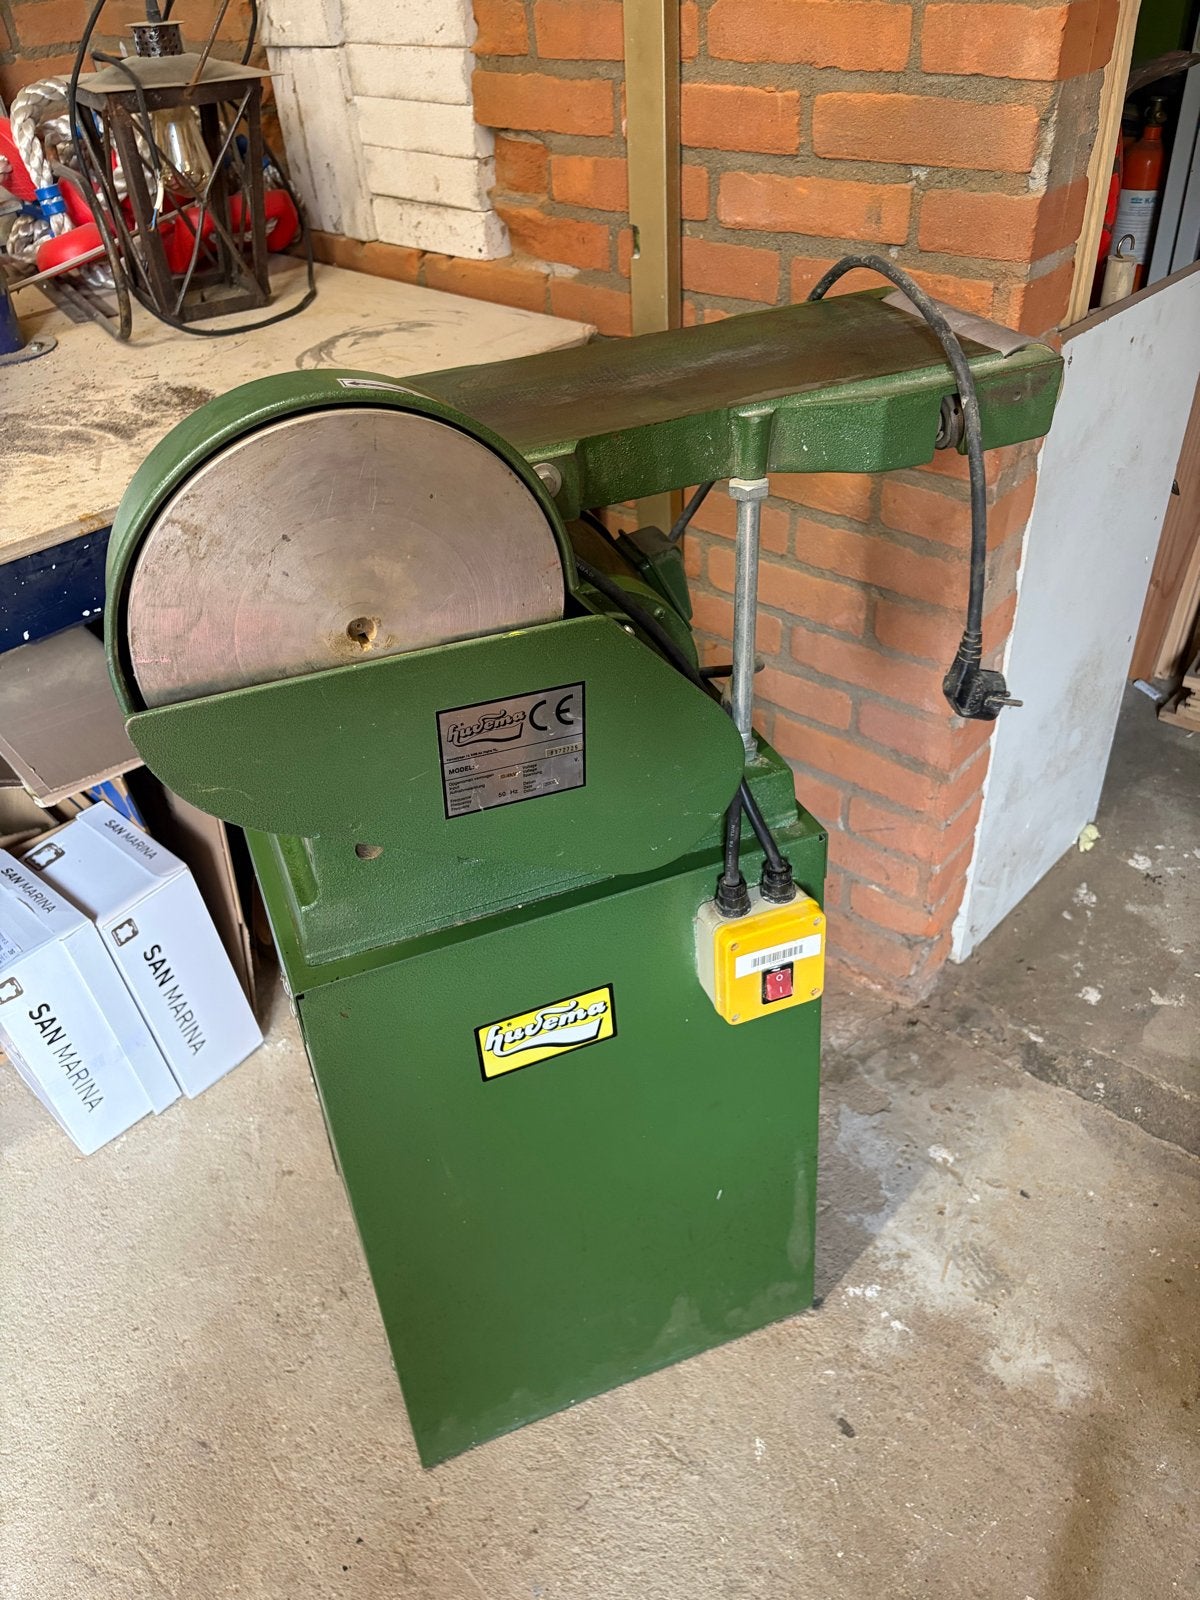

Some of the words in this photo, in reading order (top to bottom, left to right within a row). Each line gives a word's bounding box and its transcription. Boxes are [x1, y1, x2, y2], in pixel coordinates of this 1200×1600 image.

[104, 819, 127, 835] SAN
[121, 833, 158, 860] MARINA
[1, 868, 25, 884] SAN
[18, 882, 56, 913] MARINA
[143, 943, 174, 988] SAN
[164, 984, 207, 1057] MARINA
[29, 1003, 66, 1046] SAN
[53, 1042, 104, 1113] MARINA
